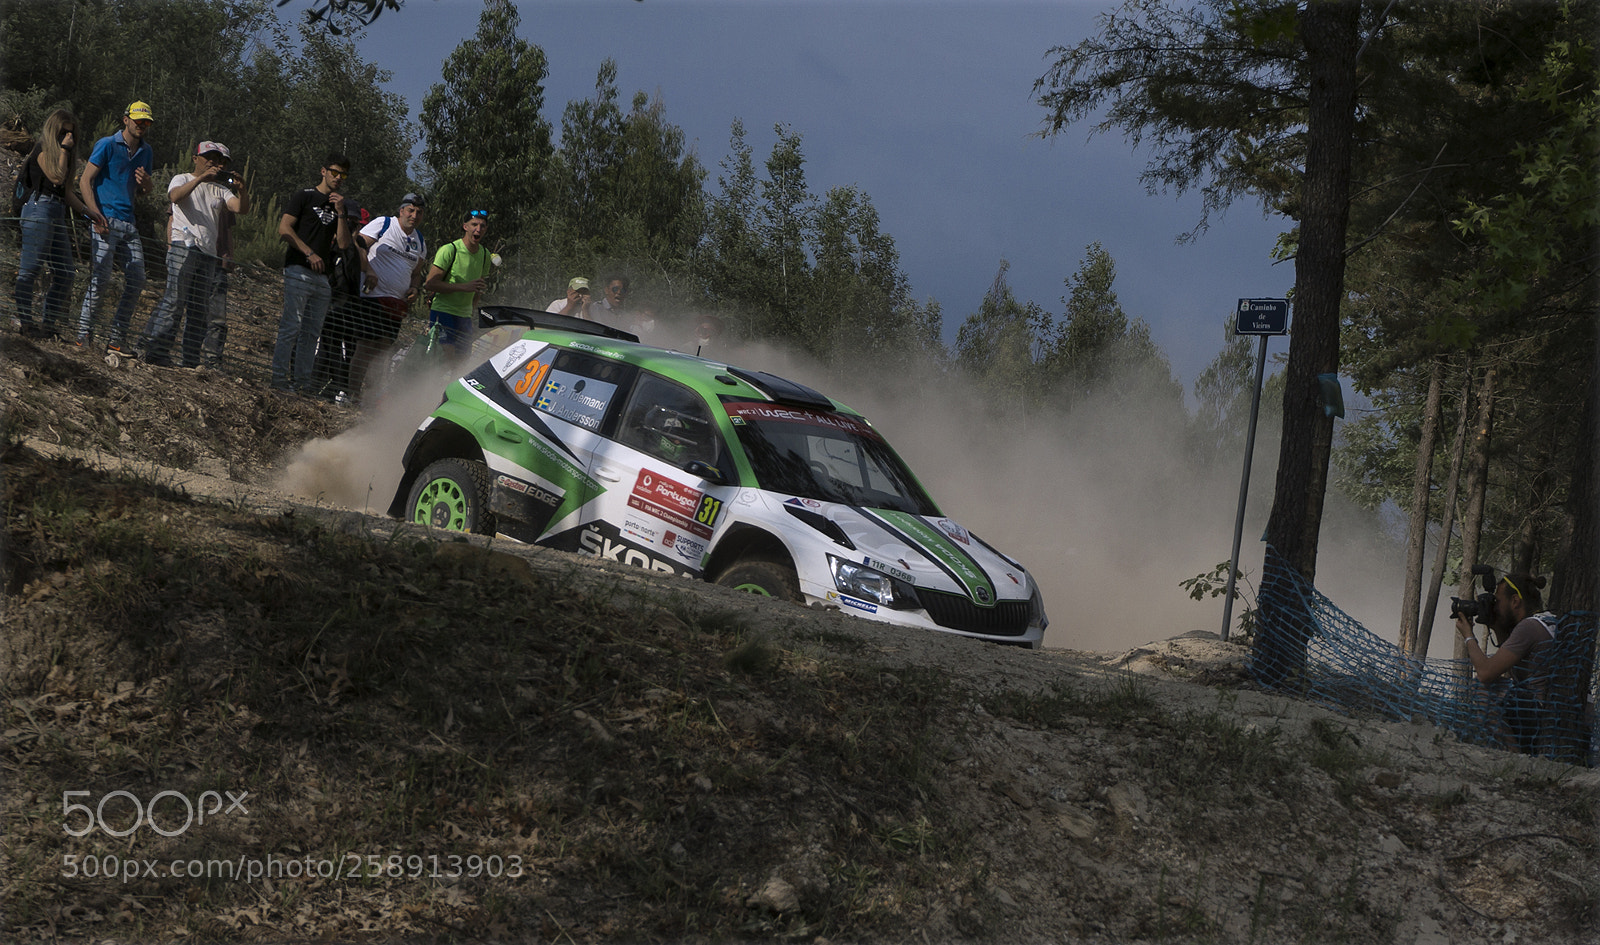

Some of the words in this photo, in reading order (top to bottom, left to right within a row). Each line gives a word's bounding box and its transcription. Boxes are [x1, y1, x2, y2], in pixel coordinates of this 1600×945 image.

[467, 378, 486, 390] R5
[514, 359, 550, 398] 31
[547, 401, 556, 413] J.
[557, 405, 600, 429] Andersson
[816, 415, 837, 427] ALL
[837, 419, 859, 432] LIVE
[503, 478, 527, 492] Castrol
[527, 487, 559, 507] EDGE
[655, 484, 697, 509] Portugal
[698, 496, 721, 526] 31
[677, 534, 705, 552] SUPPORTS
[844, 598, 877, 611] MICHELIN
